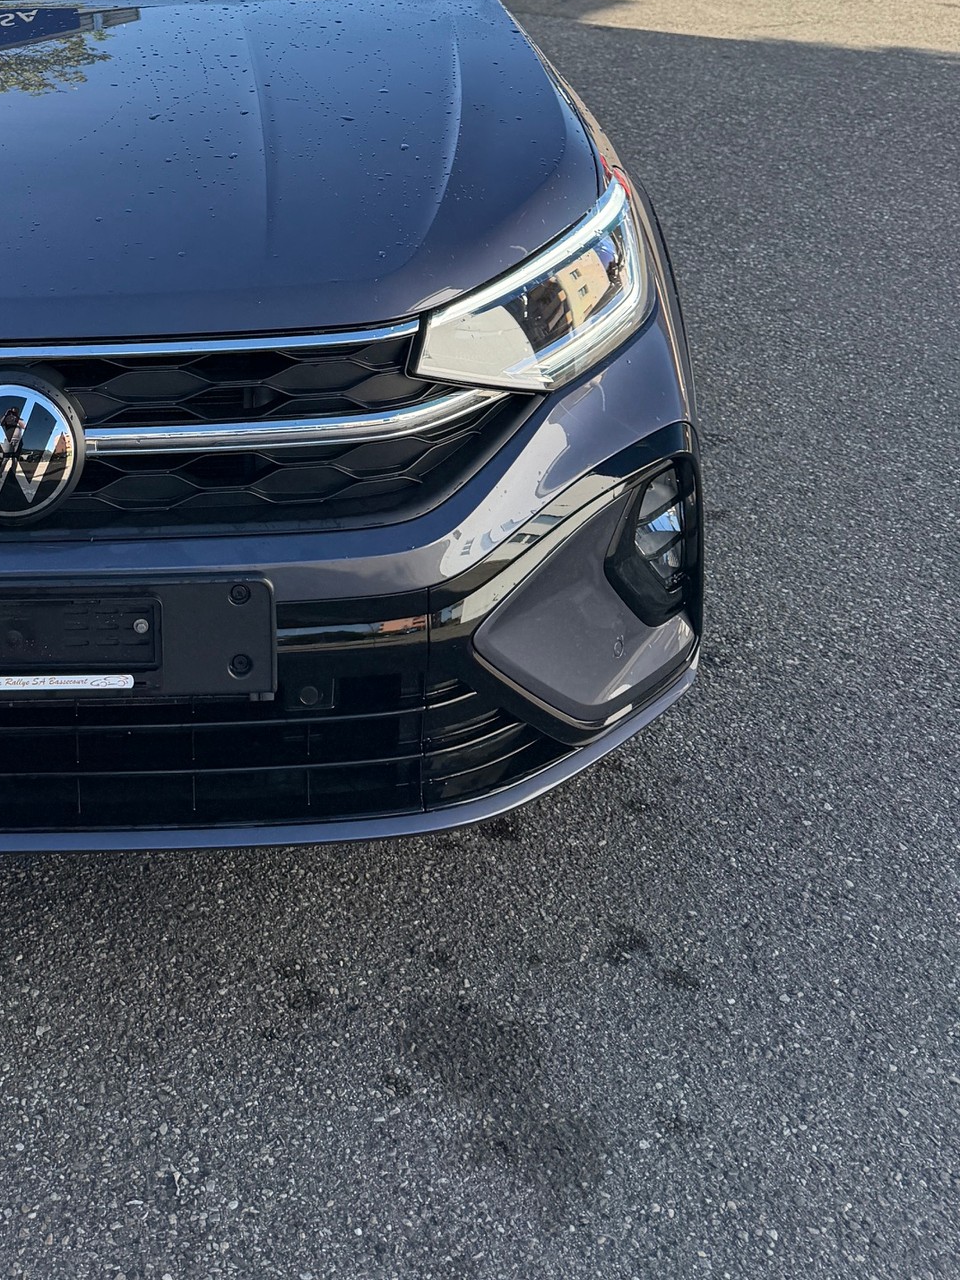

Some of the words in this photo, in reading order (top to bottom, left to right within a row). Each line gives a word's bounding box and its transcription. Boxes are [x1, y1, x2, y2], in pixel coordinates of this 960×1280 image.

[5, 677, 30, 688] Rallye
[32, 677, 46, 686] SA
[48, 676, 89, 686] Bassecourt
